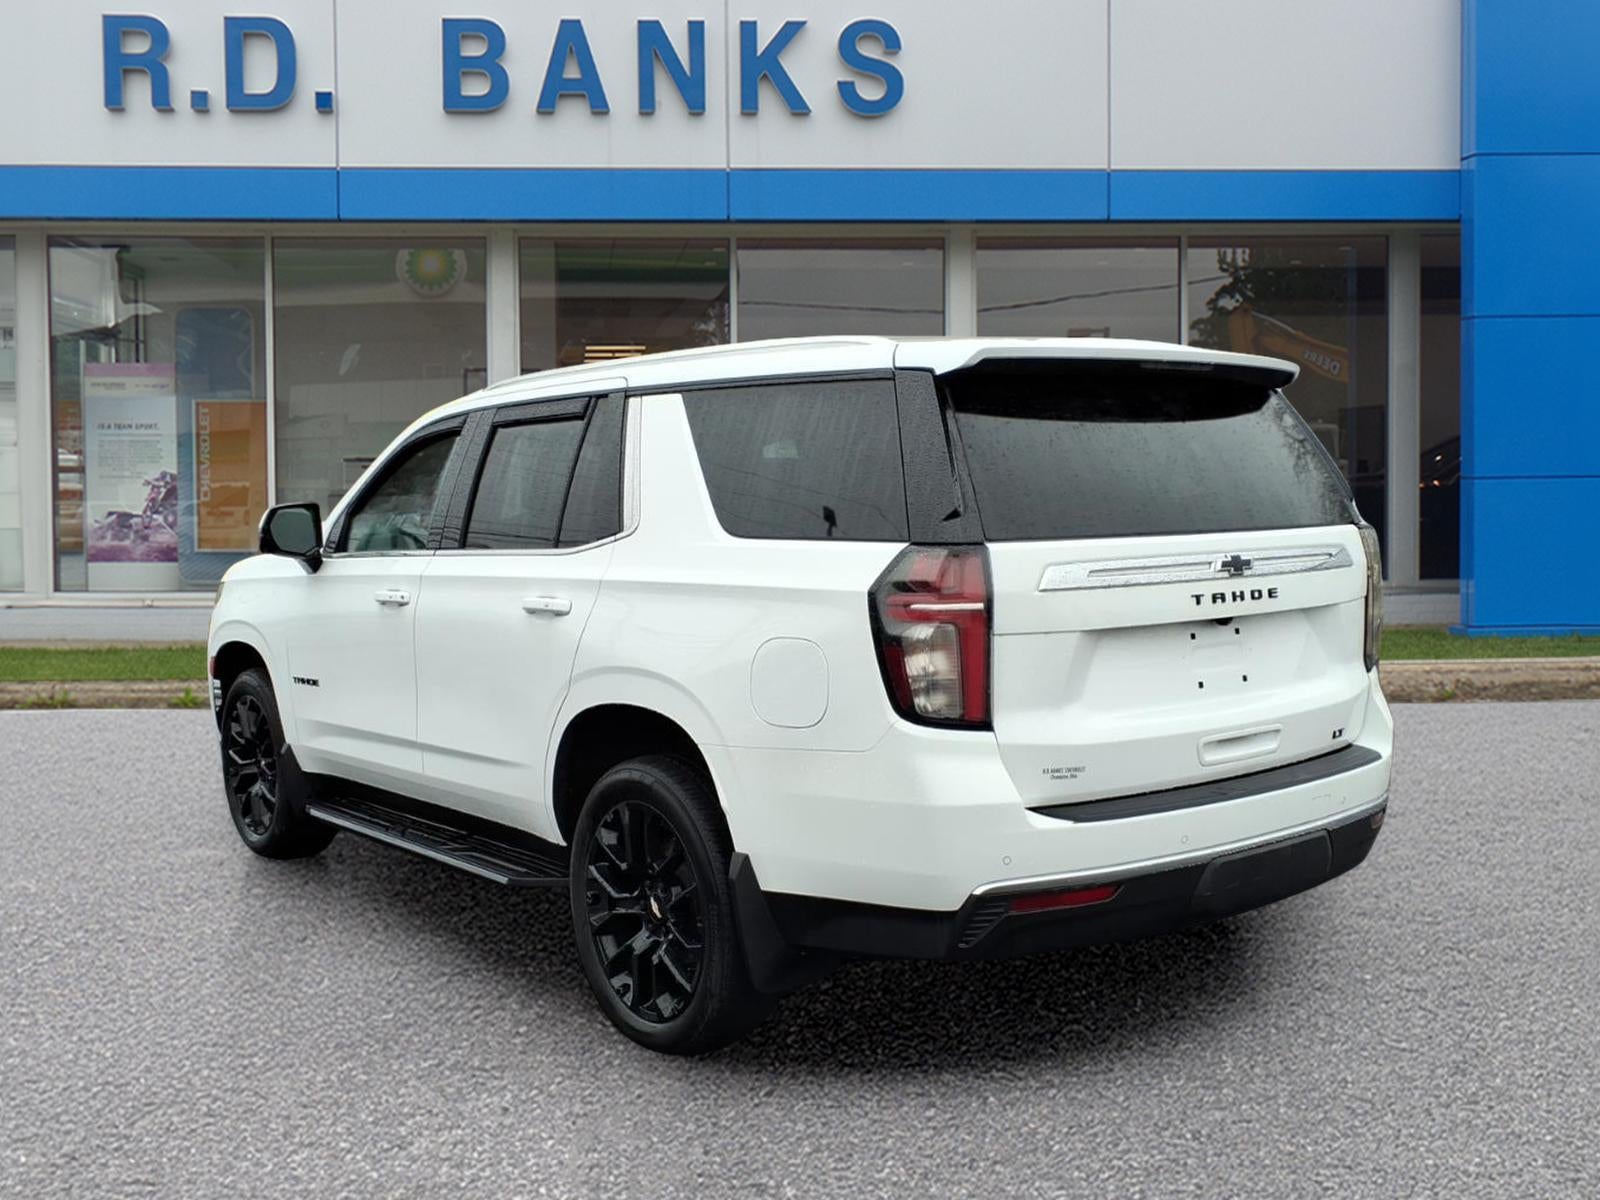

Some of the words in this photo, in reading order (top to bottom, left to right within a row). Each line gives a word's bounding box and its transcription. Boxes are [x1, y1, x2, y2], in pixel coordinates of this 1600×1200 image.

[103, 15, 334, 112] R.D.
[442, 18, 906, 117] BANKS
[199, 407, 211, 501] CHEVROLET
[1190, 587, 1279, 606] TAHOE
[1332, 728, 1345, 739] LT
